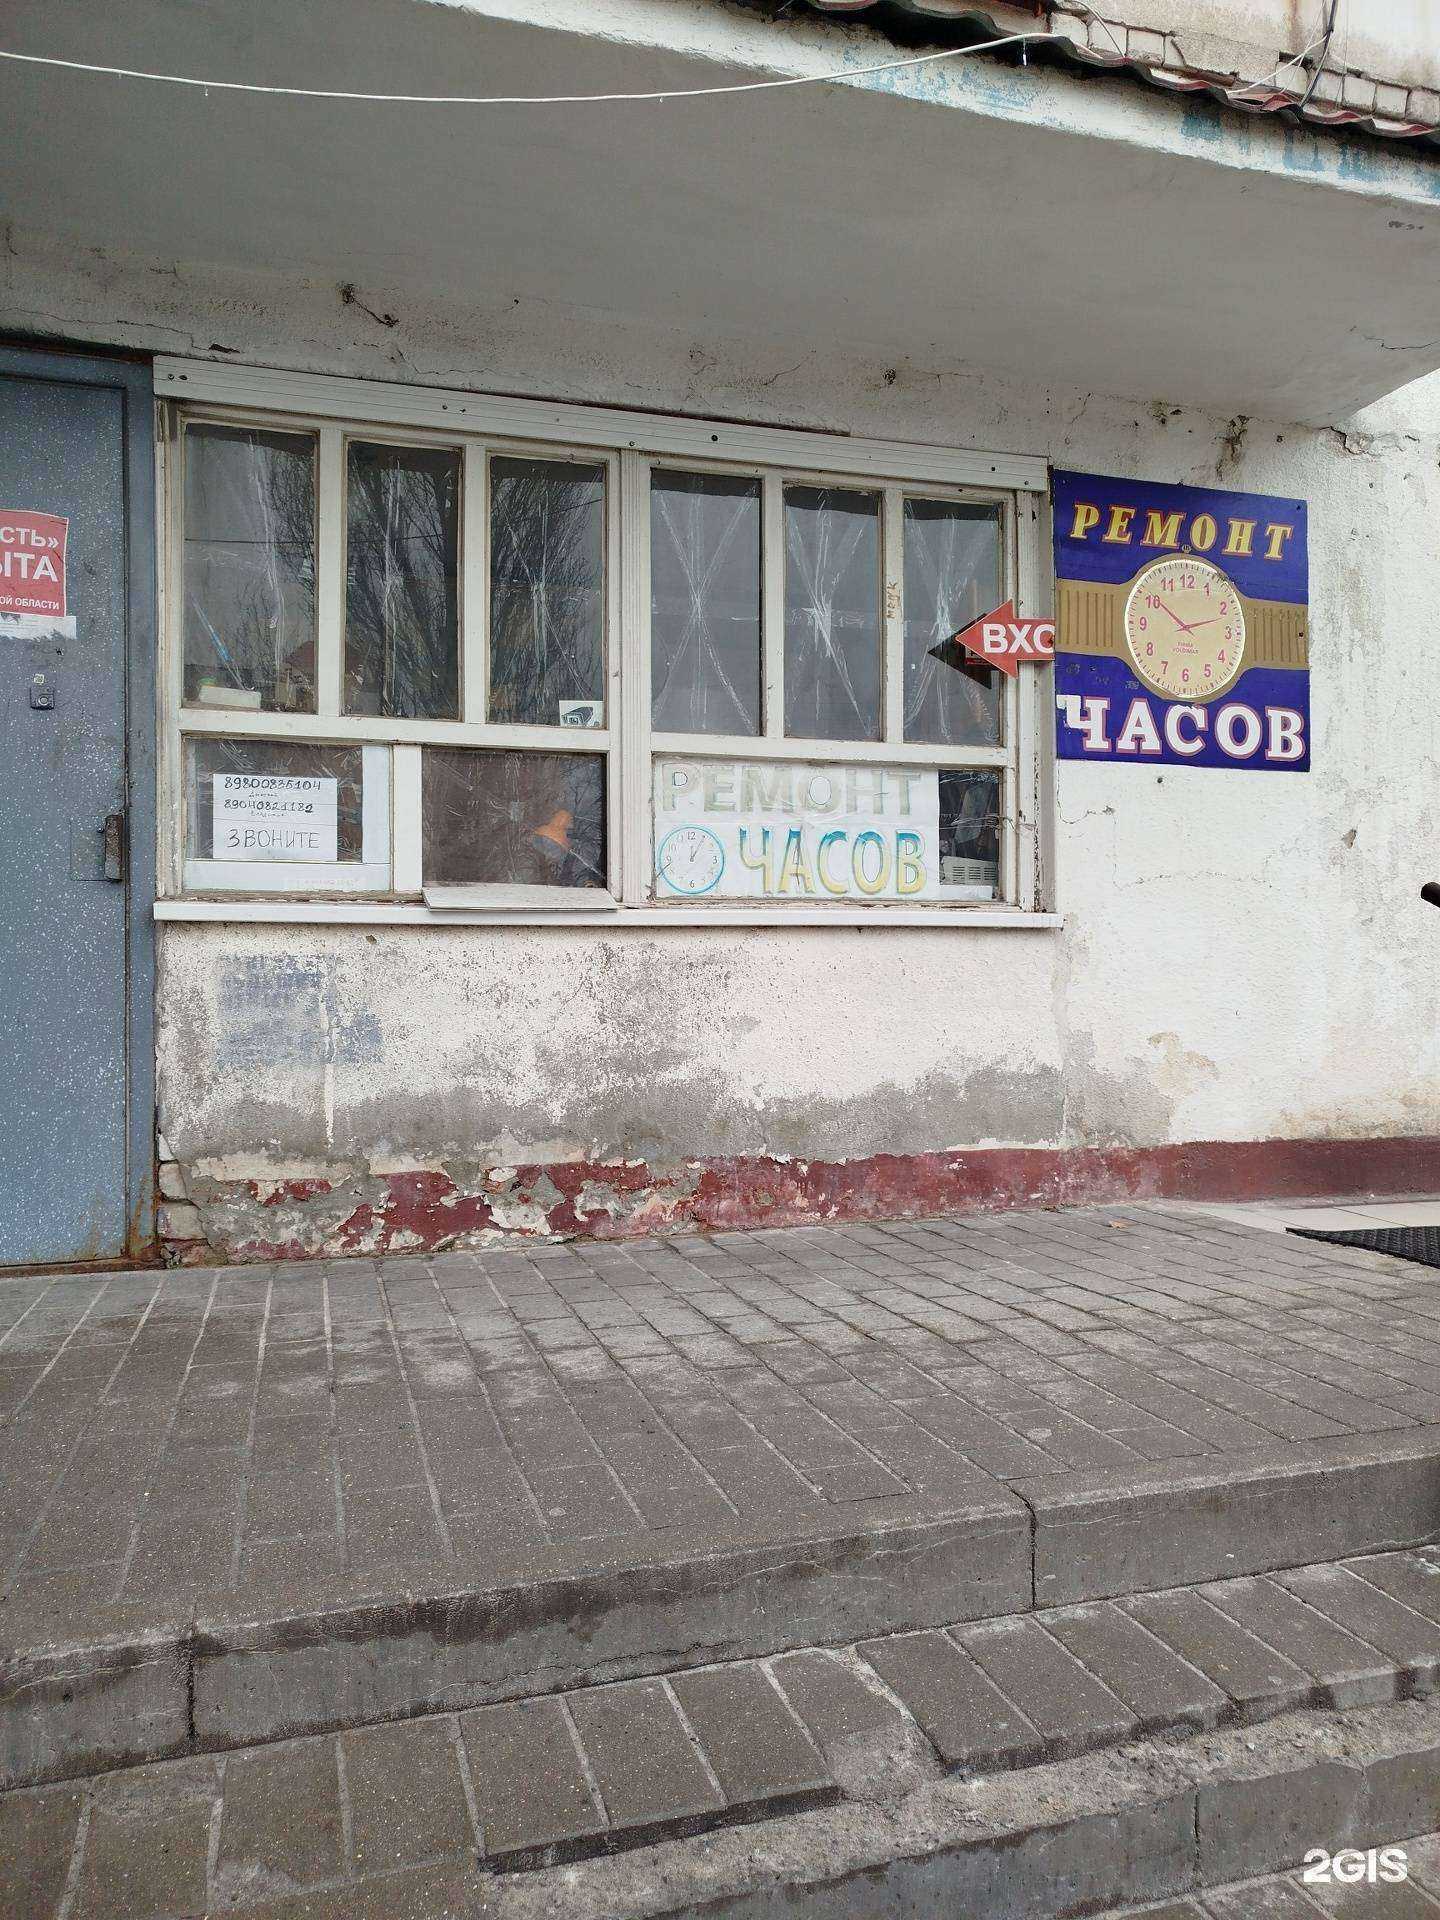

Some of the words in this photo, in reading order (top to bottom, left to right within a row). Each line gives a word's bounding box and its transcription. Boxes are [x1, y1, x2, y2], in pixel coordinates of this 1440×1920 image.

[1069, 502, 1294, 559] РЕМОНТ
[1161, 577, 1175, 592] 11
[1180, 575, 1195, 589] 12
[1204, 583, 1210, 596] 1
[15, 597, 59, 610] ОБЛАСТИ
[1146, 595, 1160, 608] 10
[1220, 601, 1227, 615] 2
[1140, 617, 1147, 631] 9
[1225, 626, 1231, 640] 3
[1147, 642, 1153, 656] 8
[1218, 649, 1225, 663] 4
[1161, 661, 1168, 674] 7
[1205, 664, 1211, 677] 5
[1182, 668, 1189, 682] 6
[1056, 694, 1305, 761] ЧАСОВ
[662, 763, 921, 816] РЕМОНТ
[227, 828, 320, 849] ЗВОНИТЕ
[687, 831, 695, 840] 12
[712, 855, 718, 864] 3
[739, 828, 927, 895] ЧАСОВ
